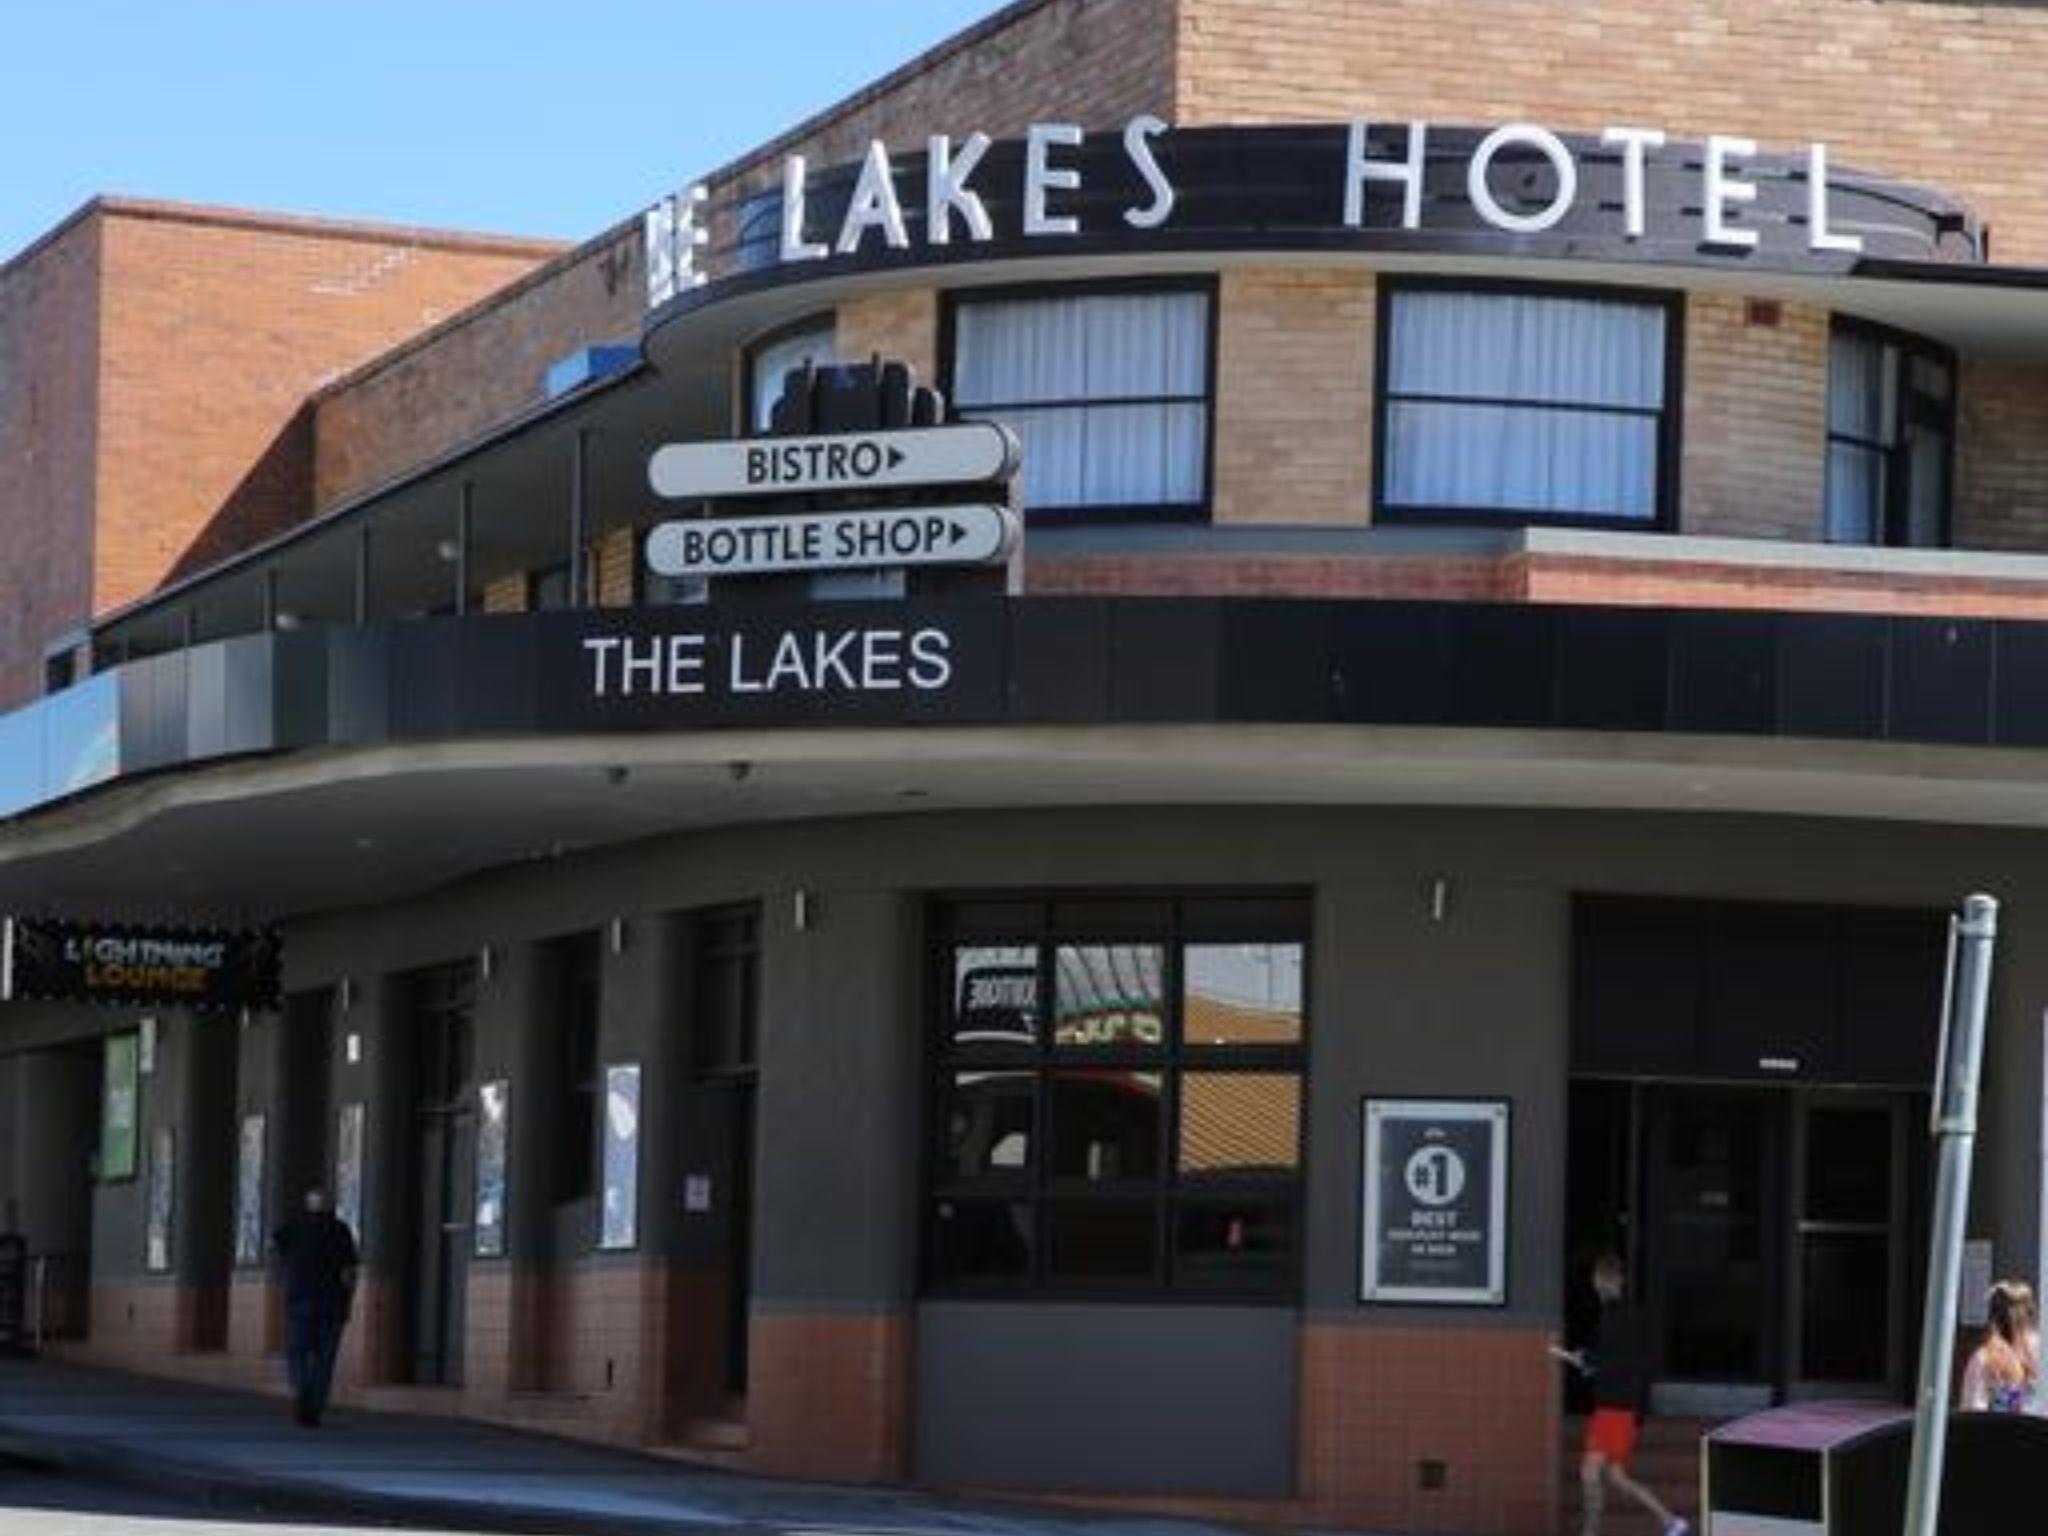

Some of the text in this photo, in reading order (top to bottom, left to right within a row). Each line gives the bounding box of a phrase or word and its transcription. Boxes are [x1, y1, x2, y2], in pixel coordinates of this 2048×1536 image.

[779, 114, 1175, 262] LAKES
[1342, 120, 1864, 250] HOTEL
[746, 442, 881, 484] BISTRO
[682, 517, 942, 565] BOTTLE SHOP
[584, 629, 950, 695] THE LAKES
[1415, 1153, 1448, 1196] #1
